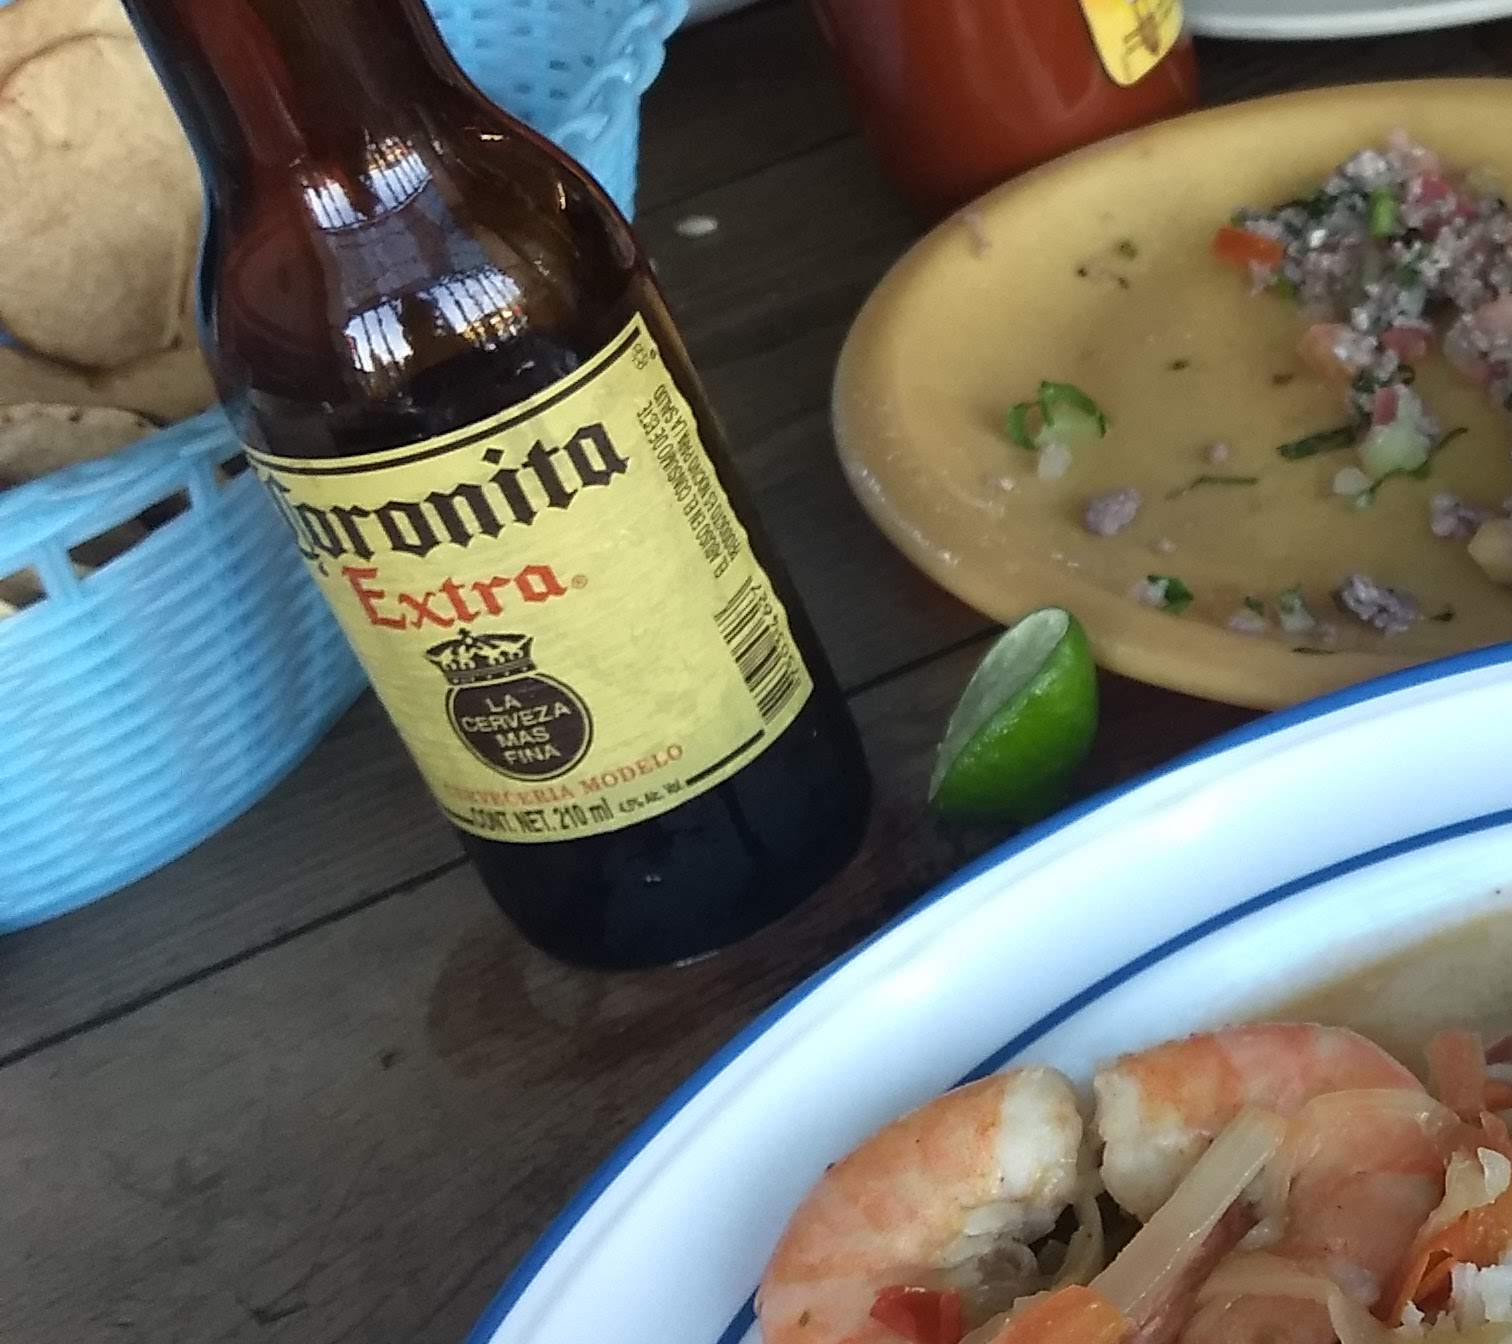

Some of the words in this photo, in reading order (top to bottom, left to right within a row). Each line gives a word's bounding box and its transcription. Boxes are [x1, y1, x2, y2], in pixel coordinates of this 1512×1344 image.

[647, 426, 668, 451] DE
[655, 442, 693, 502] CONSUMO
[341, 564, 568, 630] Extra
[461, 701, 572, 733] CERVEZA
[485, 693, 522, 713] LA
[495, 726, 550, 748] MAS
[503, 743, 563, 765] FINA
[444, 782, 575, 807] RVECERIA
[579, 743, 684, 794] MODELO
[553, 800, 588, 830] 210
[588, 796, 615, 823] ml
